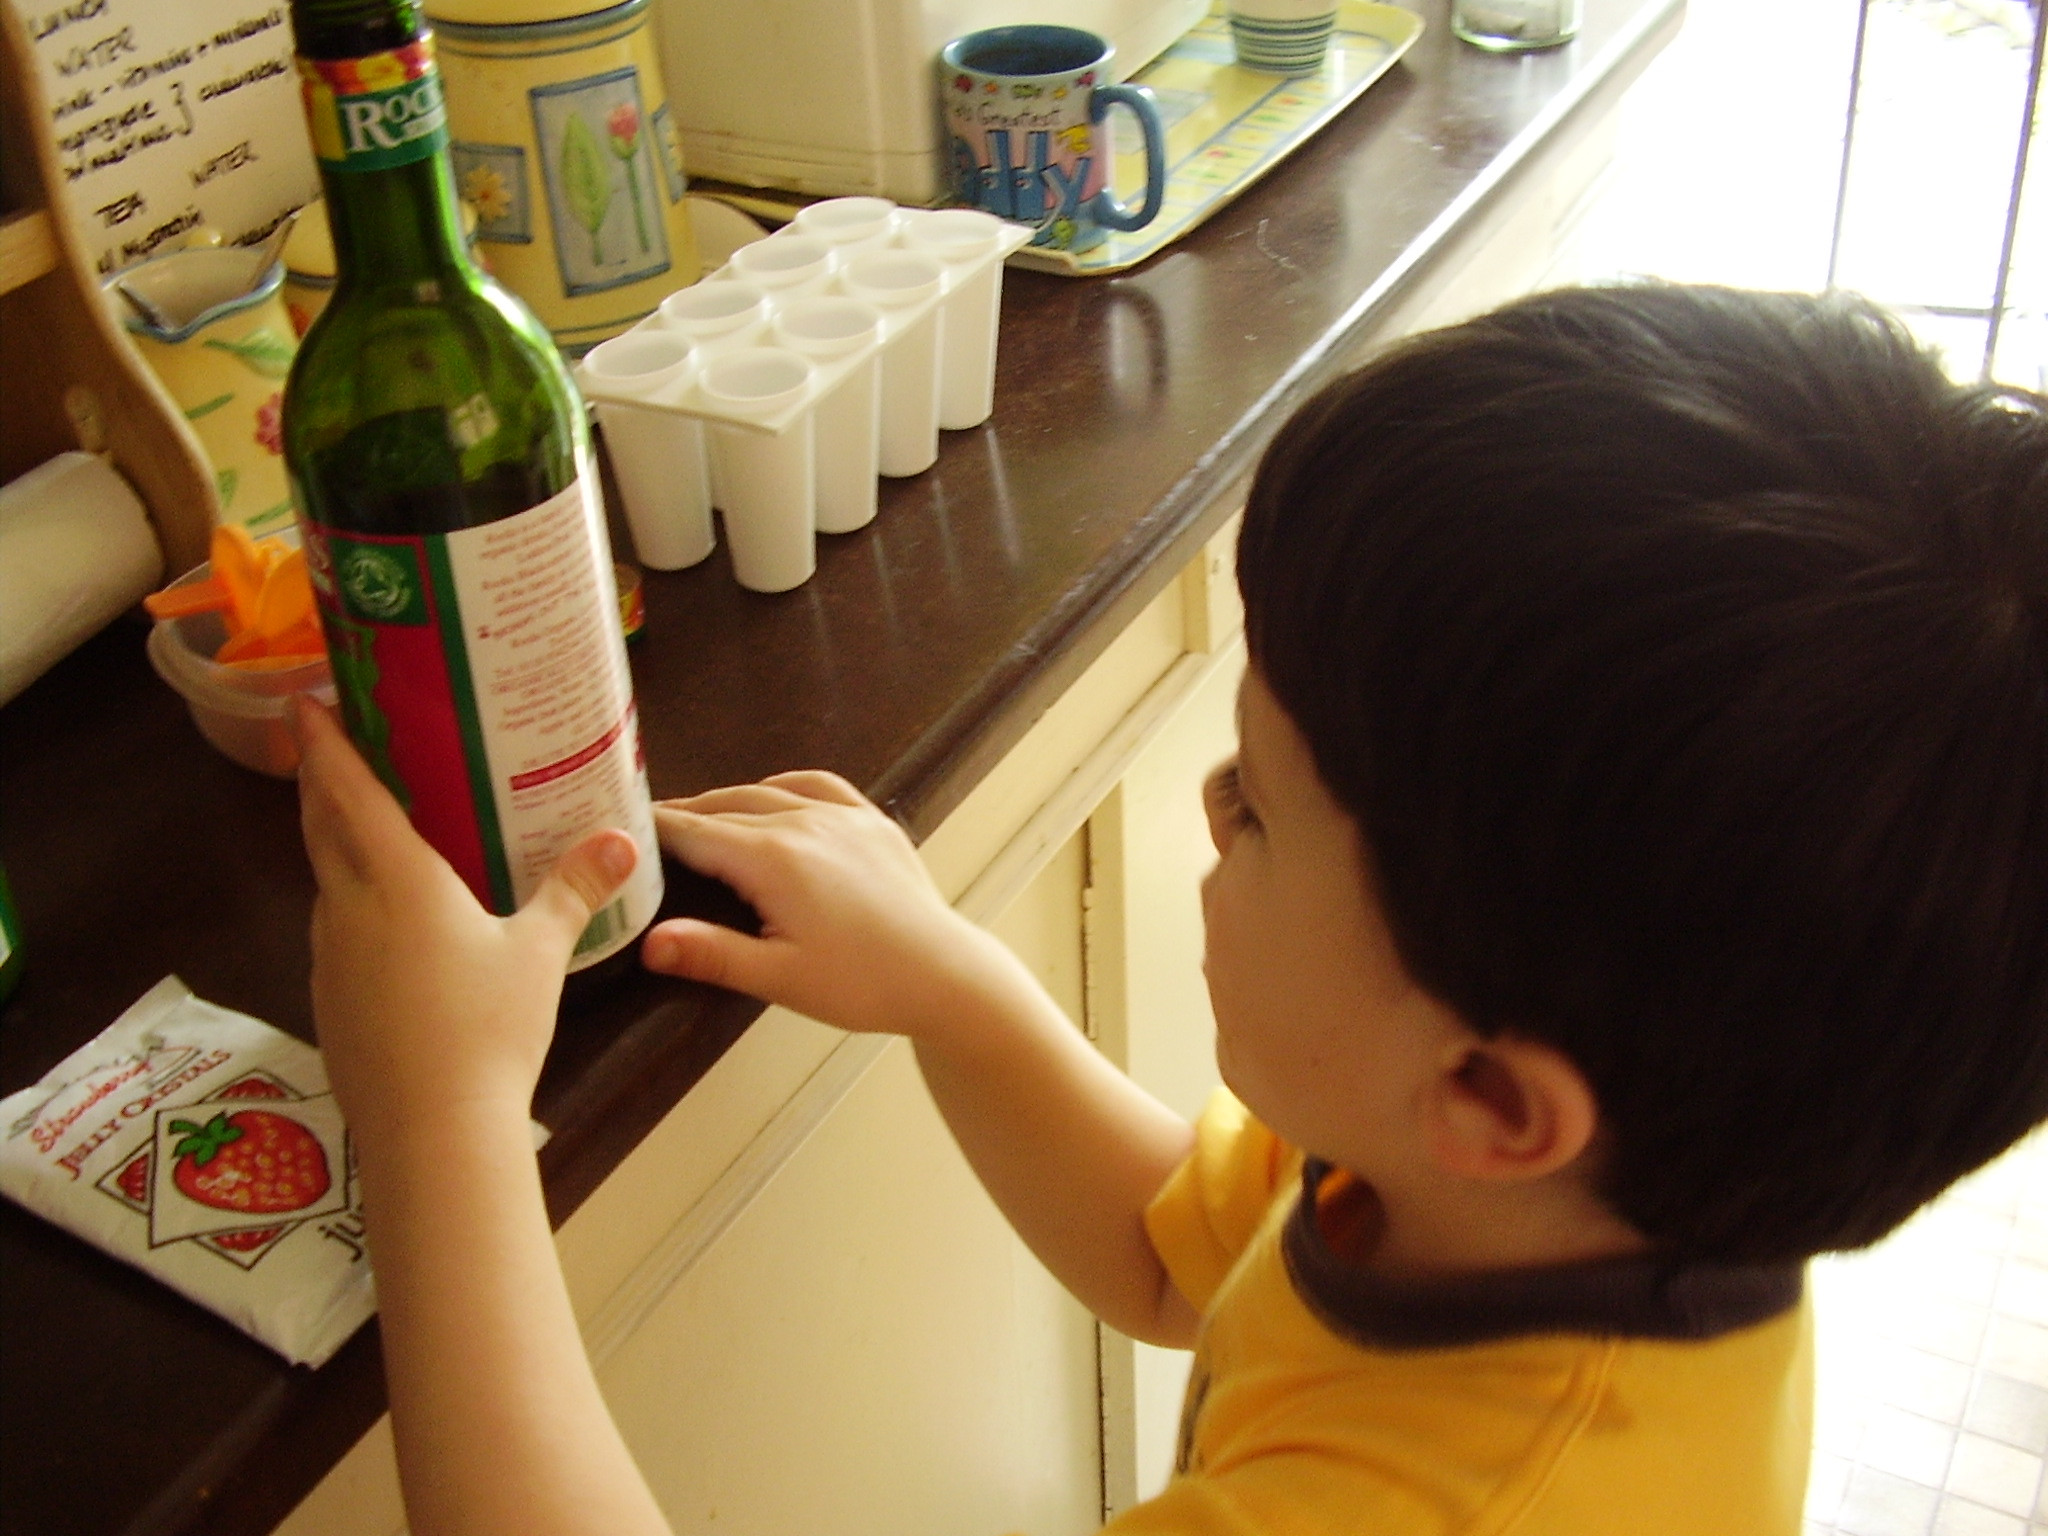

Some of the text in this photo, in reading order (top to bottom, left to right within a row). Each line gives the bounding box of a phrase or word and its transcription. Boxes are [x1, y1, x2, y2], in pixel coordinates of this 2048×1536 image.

[54, 26, 138, 77] WATER
[189, 139, 258, 188] WATER
[94, 191, 146, 229] TEA
[56, 1049, 232, 1181] JELLY CRYSTALS
